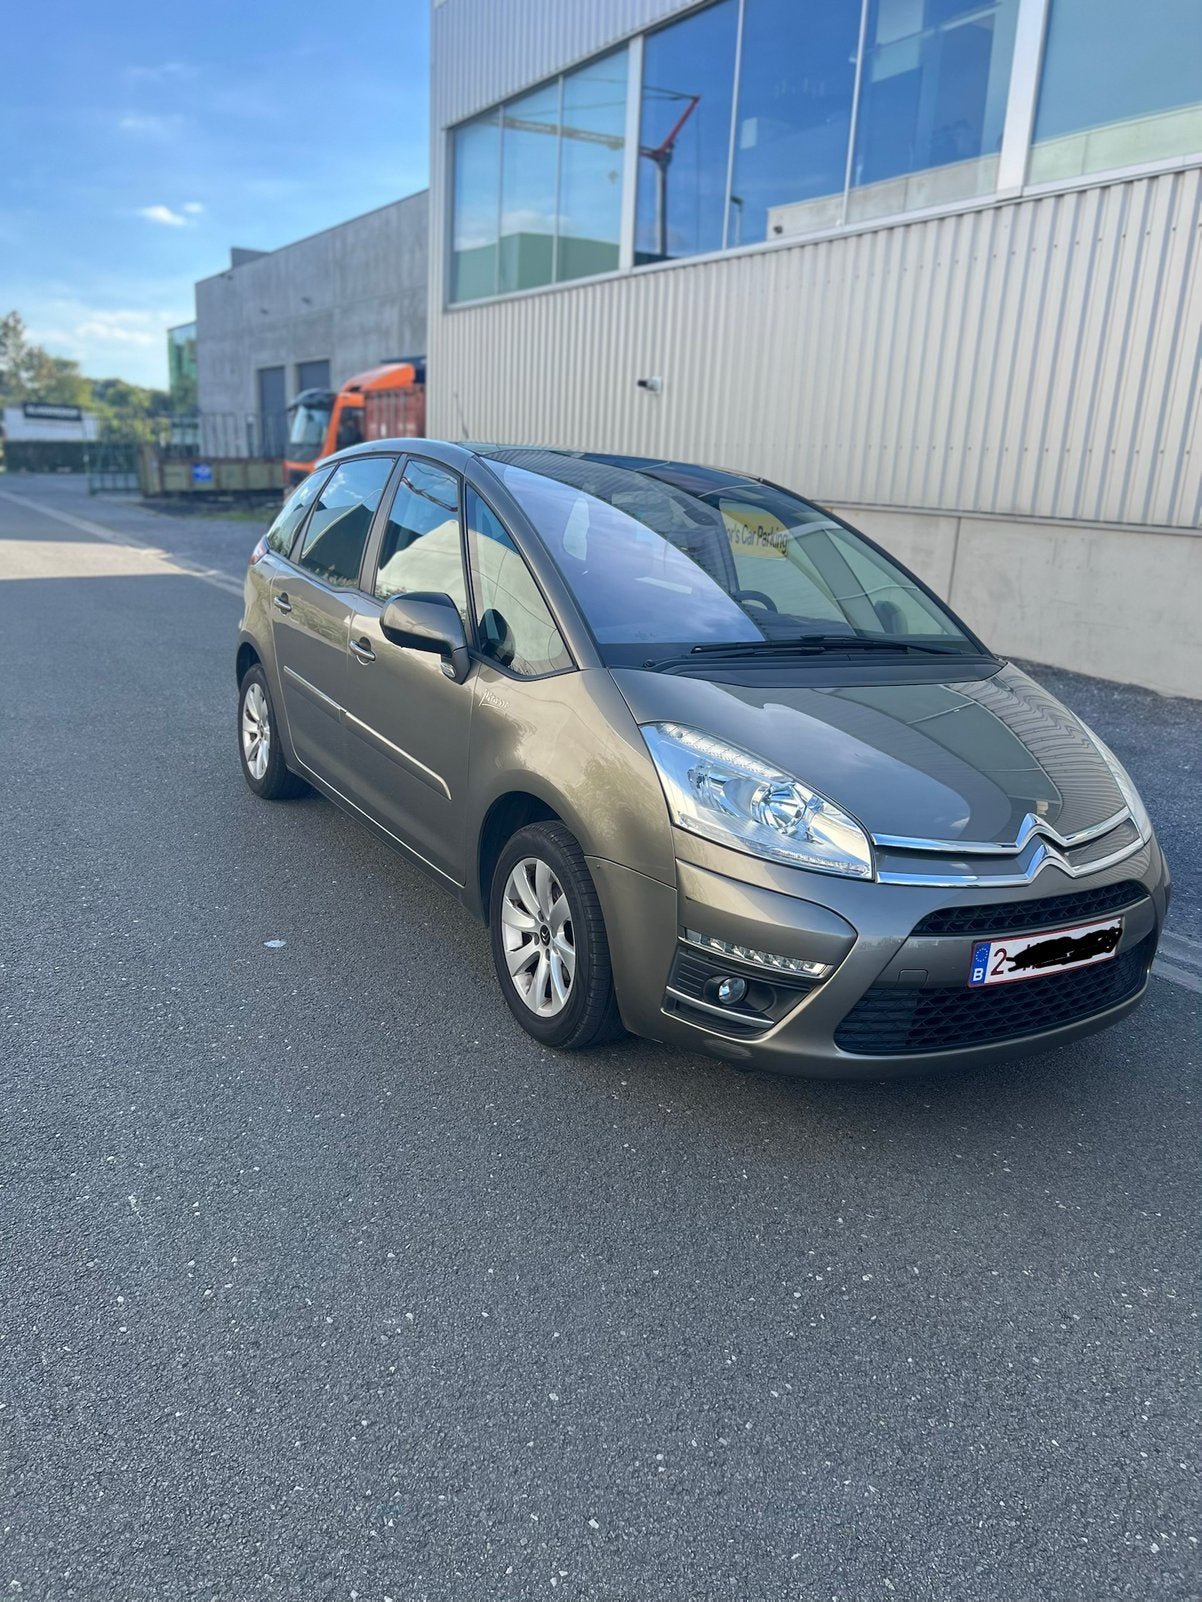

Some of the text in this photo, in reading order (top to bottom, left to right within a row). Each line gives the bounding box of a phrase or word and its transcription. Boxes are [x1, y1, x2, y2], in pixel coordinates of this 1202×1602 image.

[742, 524, 757, 546] Car
[757, 525, 788, 558] Parking
[973, 968, 983, 981] B
